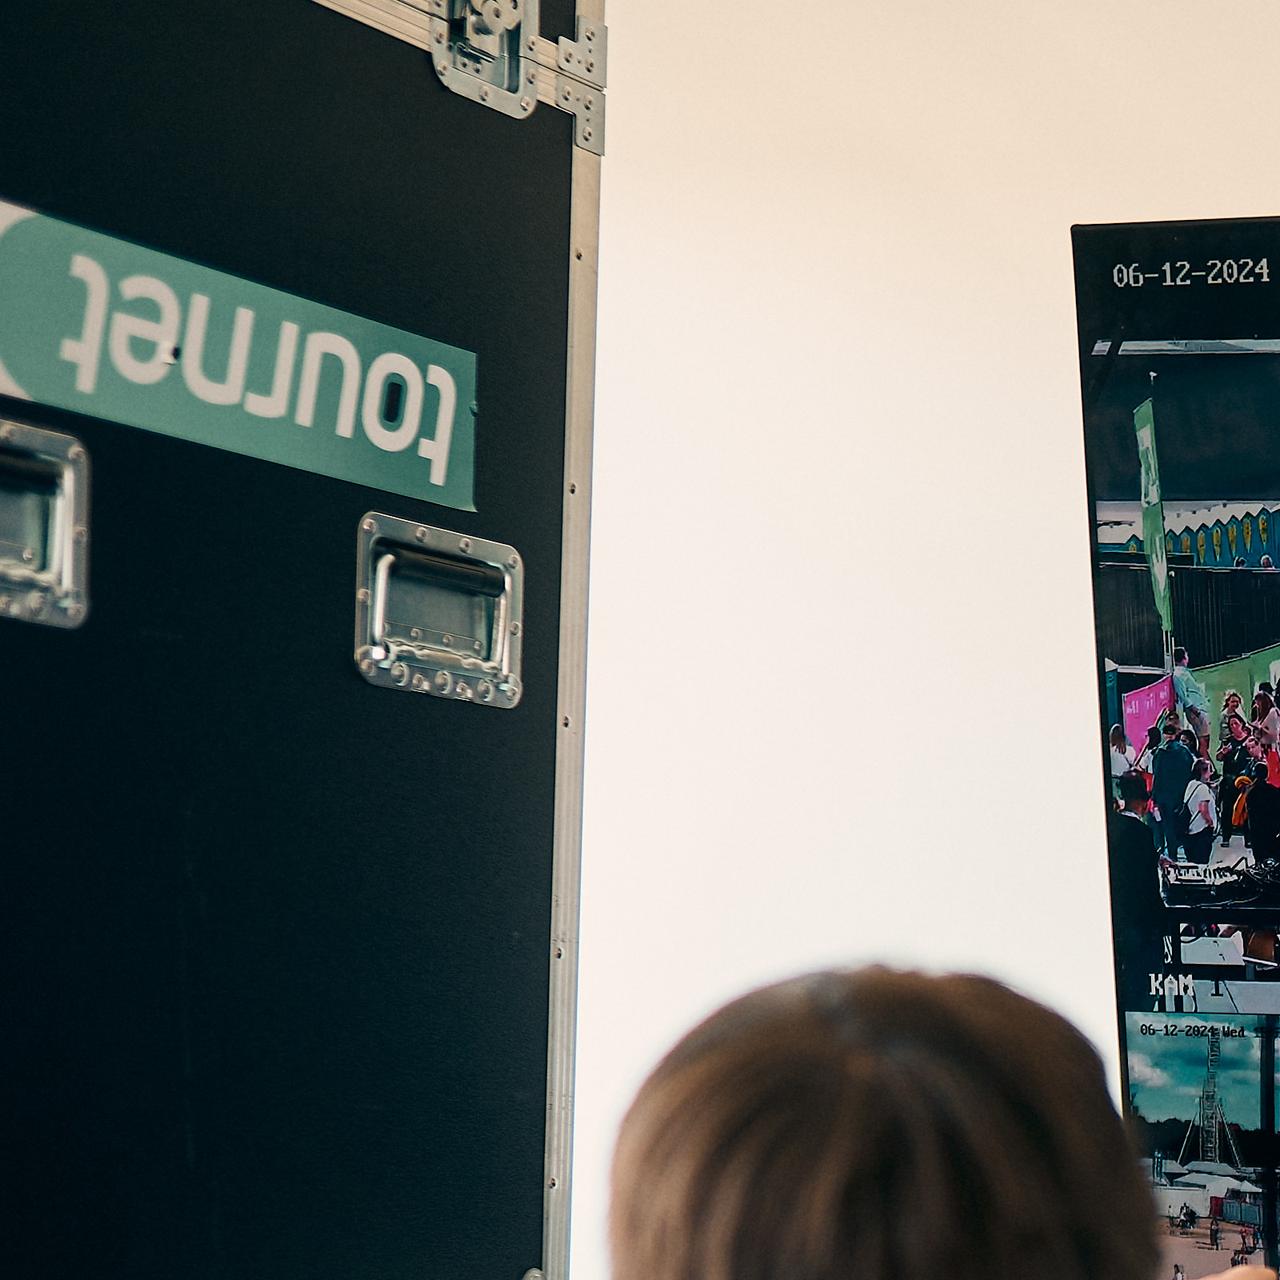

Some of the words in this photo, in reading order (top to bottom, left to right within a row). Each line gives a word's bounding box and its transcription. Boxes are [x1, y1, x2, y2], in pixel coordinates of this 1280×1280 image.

[1113, 258, 1270, 288] 06-12-2024
[59, 253, 457, 486] tournet
[1149, 973, 1194, 996] KAM
[1140, 1024, 1215, 1037] 06-12-2024
[1222, 1026, 1246, 1038] Wed
